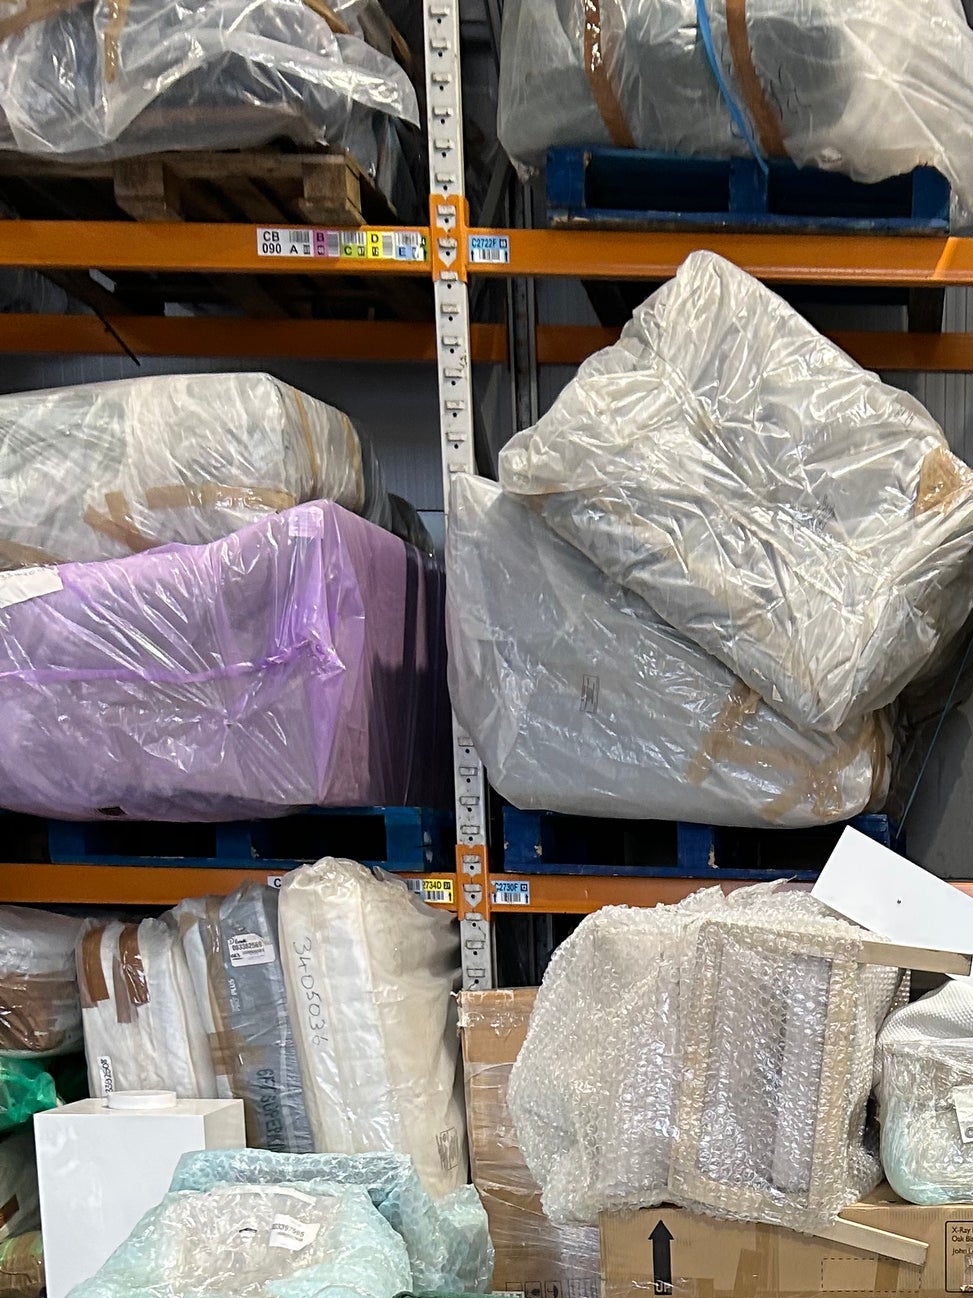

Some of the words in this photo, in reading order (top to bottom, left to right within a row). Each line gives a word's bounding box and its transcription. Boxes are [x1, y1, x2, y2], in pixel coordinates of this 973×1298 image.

[262, 231, 280, 242] CB
[316, 232, 325, 242] B
[371, 233, 379, 243] D
[262, 243, 282, 254] 090
[289, 244, 299, 255] A
[344, 246, 353, 256] C
[422, 880, 442, 890] 2734D
[293, 936, 329, 1046] 3405036
[951, 1226, 971, 1235] X-Ray
[952, 1247, 967, 1256] John
